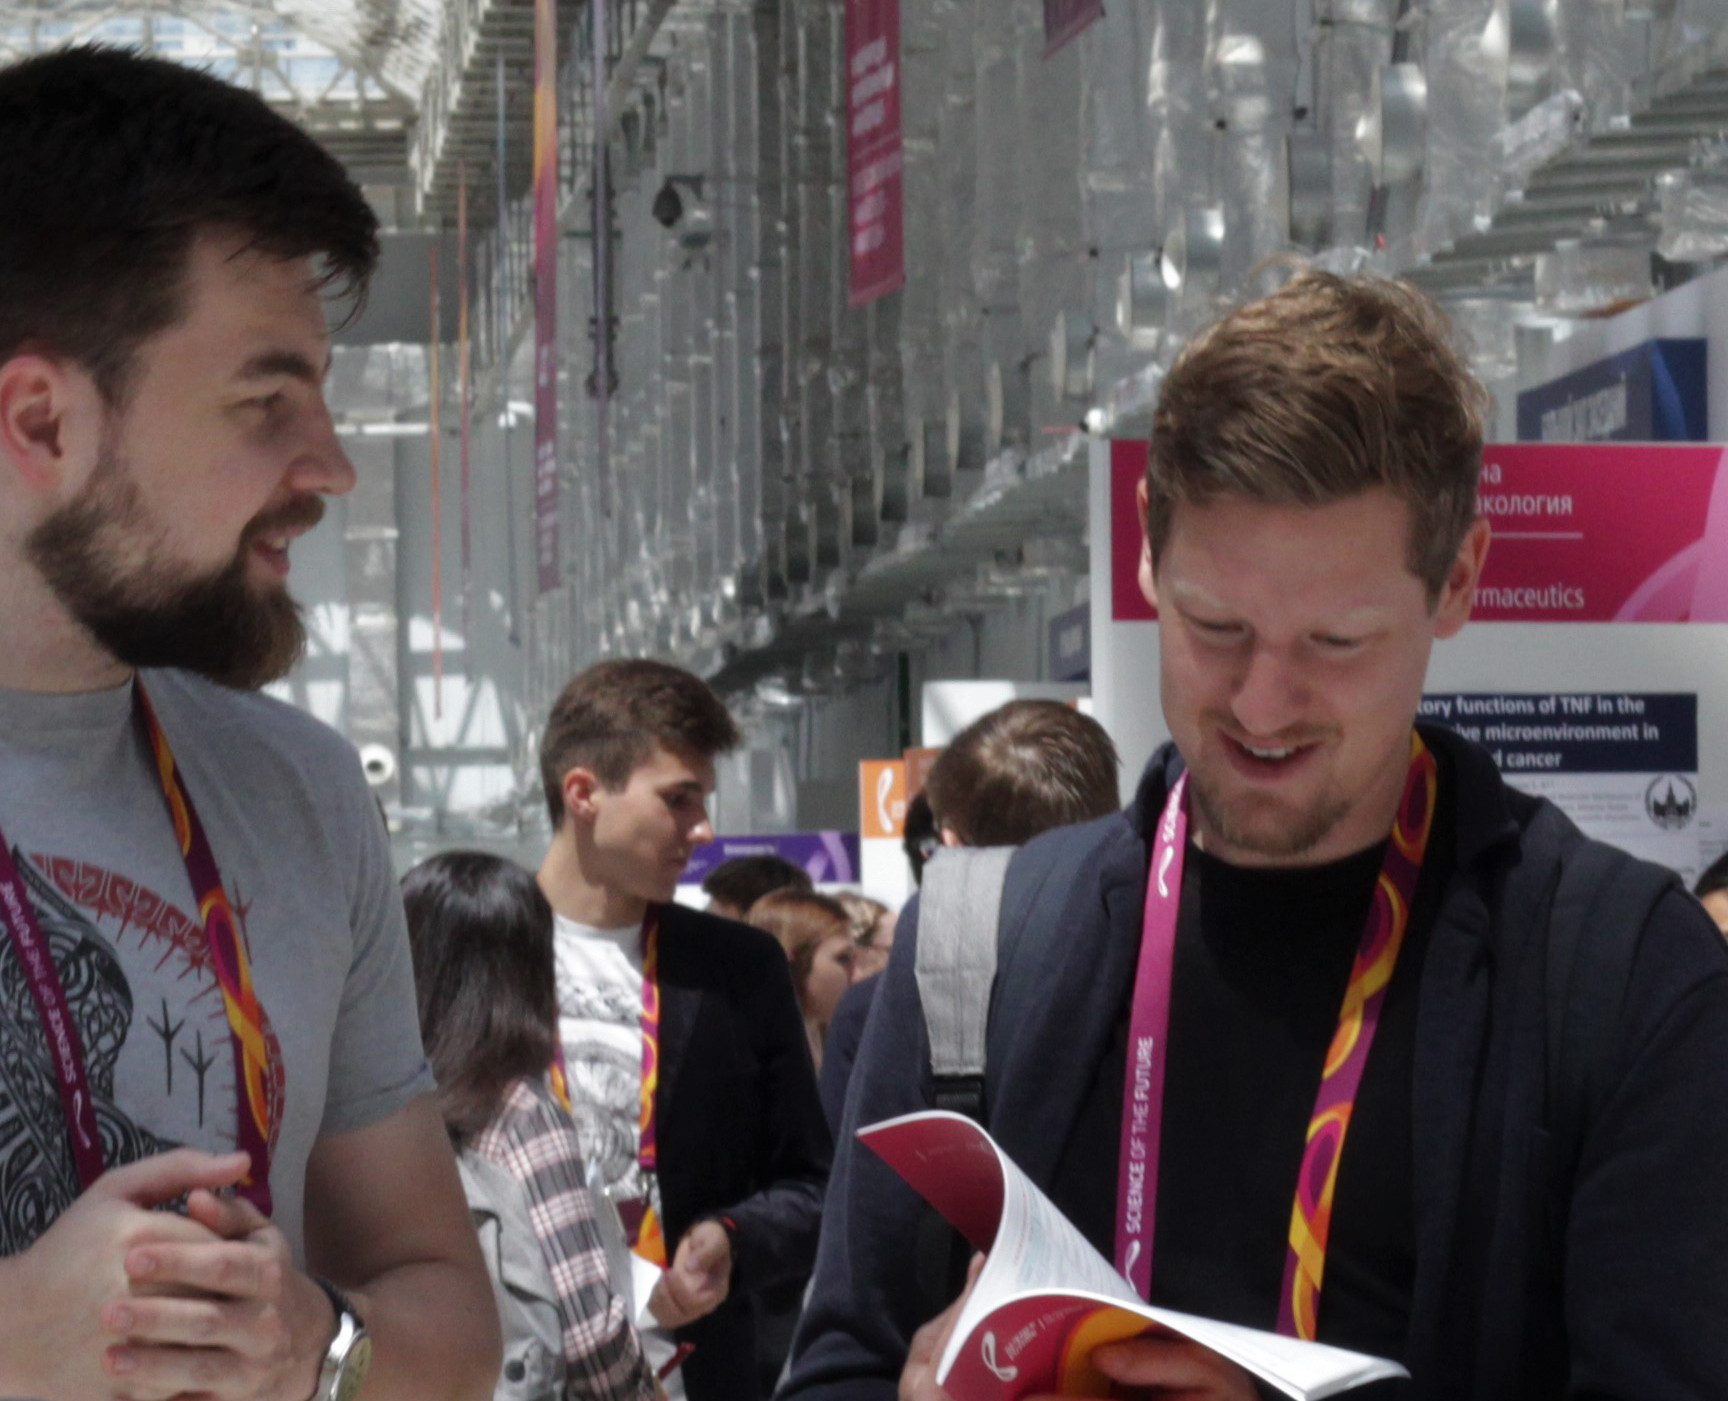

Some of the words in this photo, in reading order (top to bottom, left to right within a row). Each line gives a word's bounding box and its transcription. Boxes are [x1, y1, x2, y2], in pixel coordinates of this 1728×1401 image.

[1456, 696, 1542, 716] functions
[1545, 696, 1557, 715] of
[1561, 696, 1592, 714] TNF
[1597, 696, 1613, 714] in
[1618, 695, 1645, 714] the
[1486, 723, 1639, 742] microenvironment
[1643, 724, 1659, 740] in
[1507, 754, 1562, 768] cancer
[0, 881, 34, 947] FUTURE
[48, 1007, 76, 1083] SCIENCE
[1135, 1036, 1153, 1100] FUTURE
[1132, 1102, 1148, 1135] THE
[1130, 1136, 1146, 1159] OF
[1126, 1160, 1145, 1233] SCIENCE
